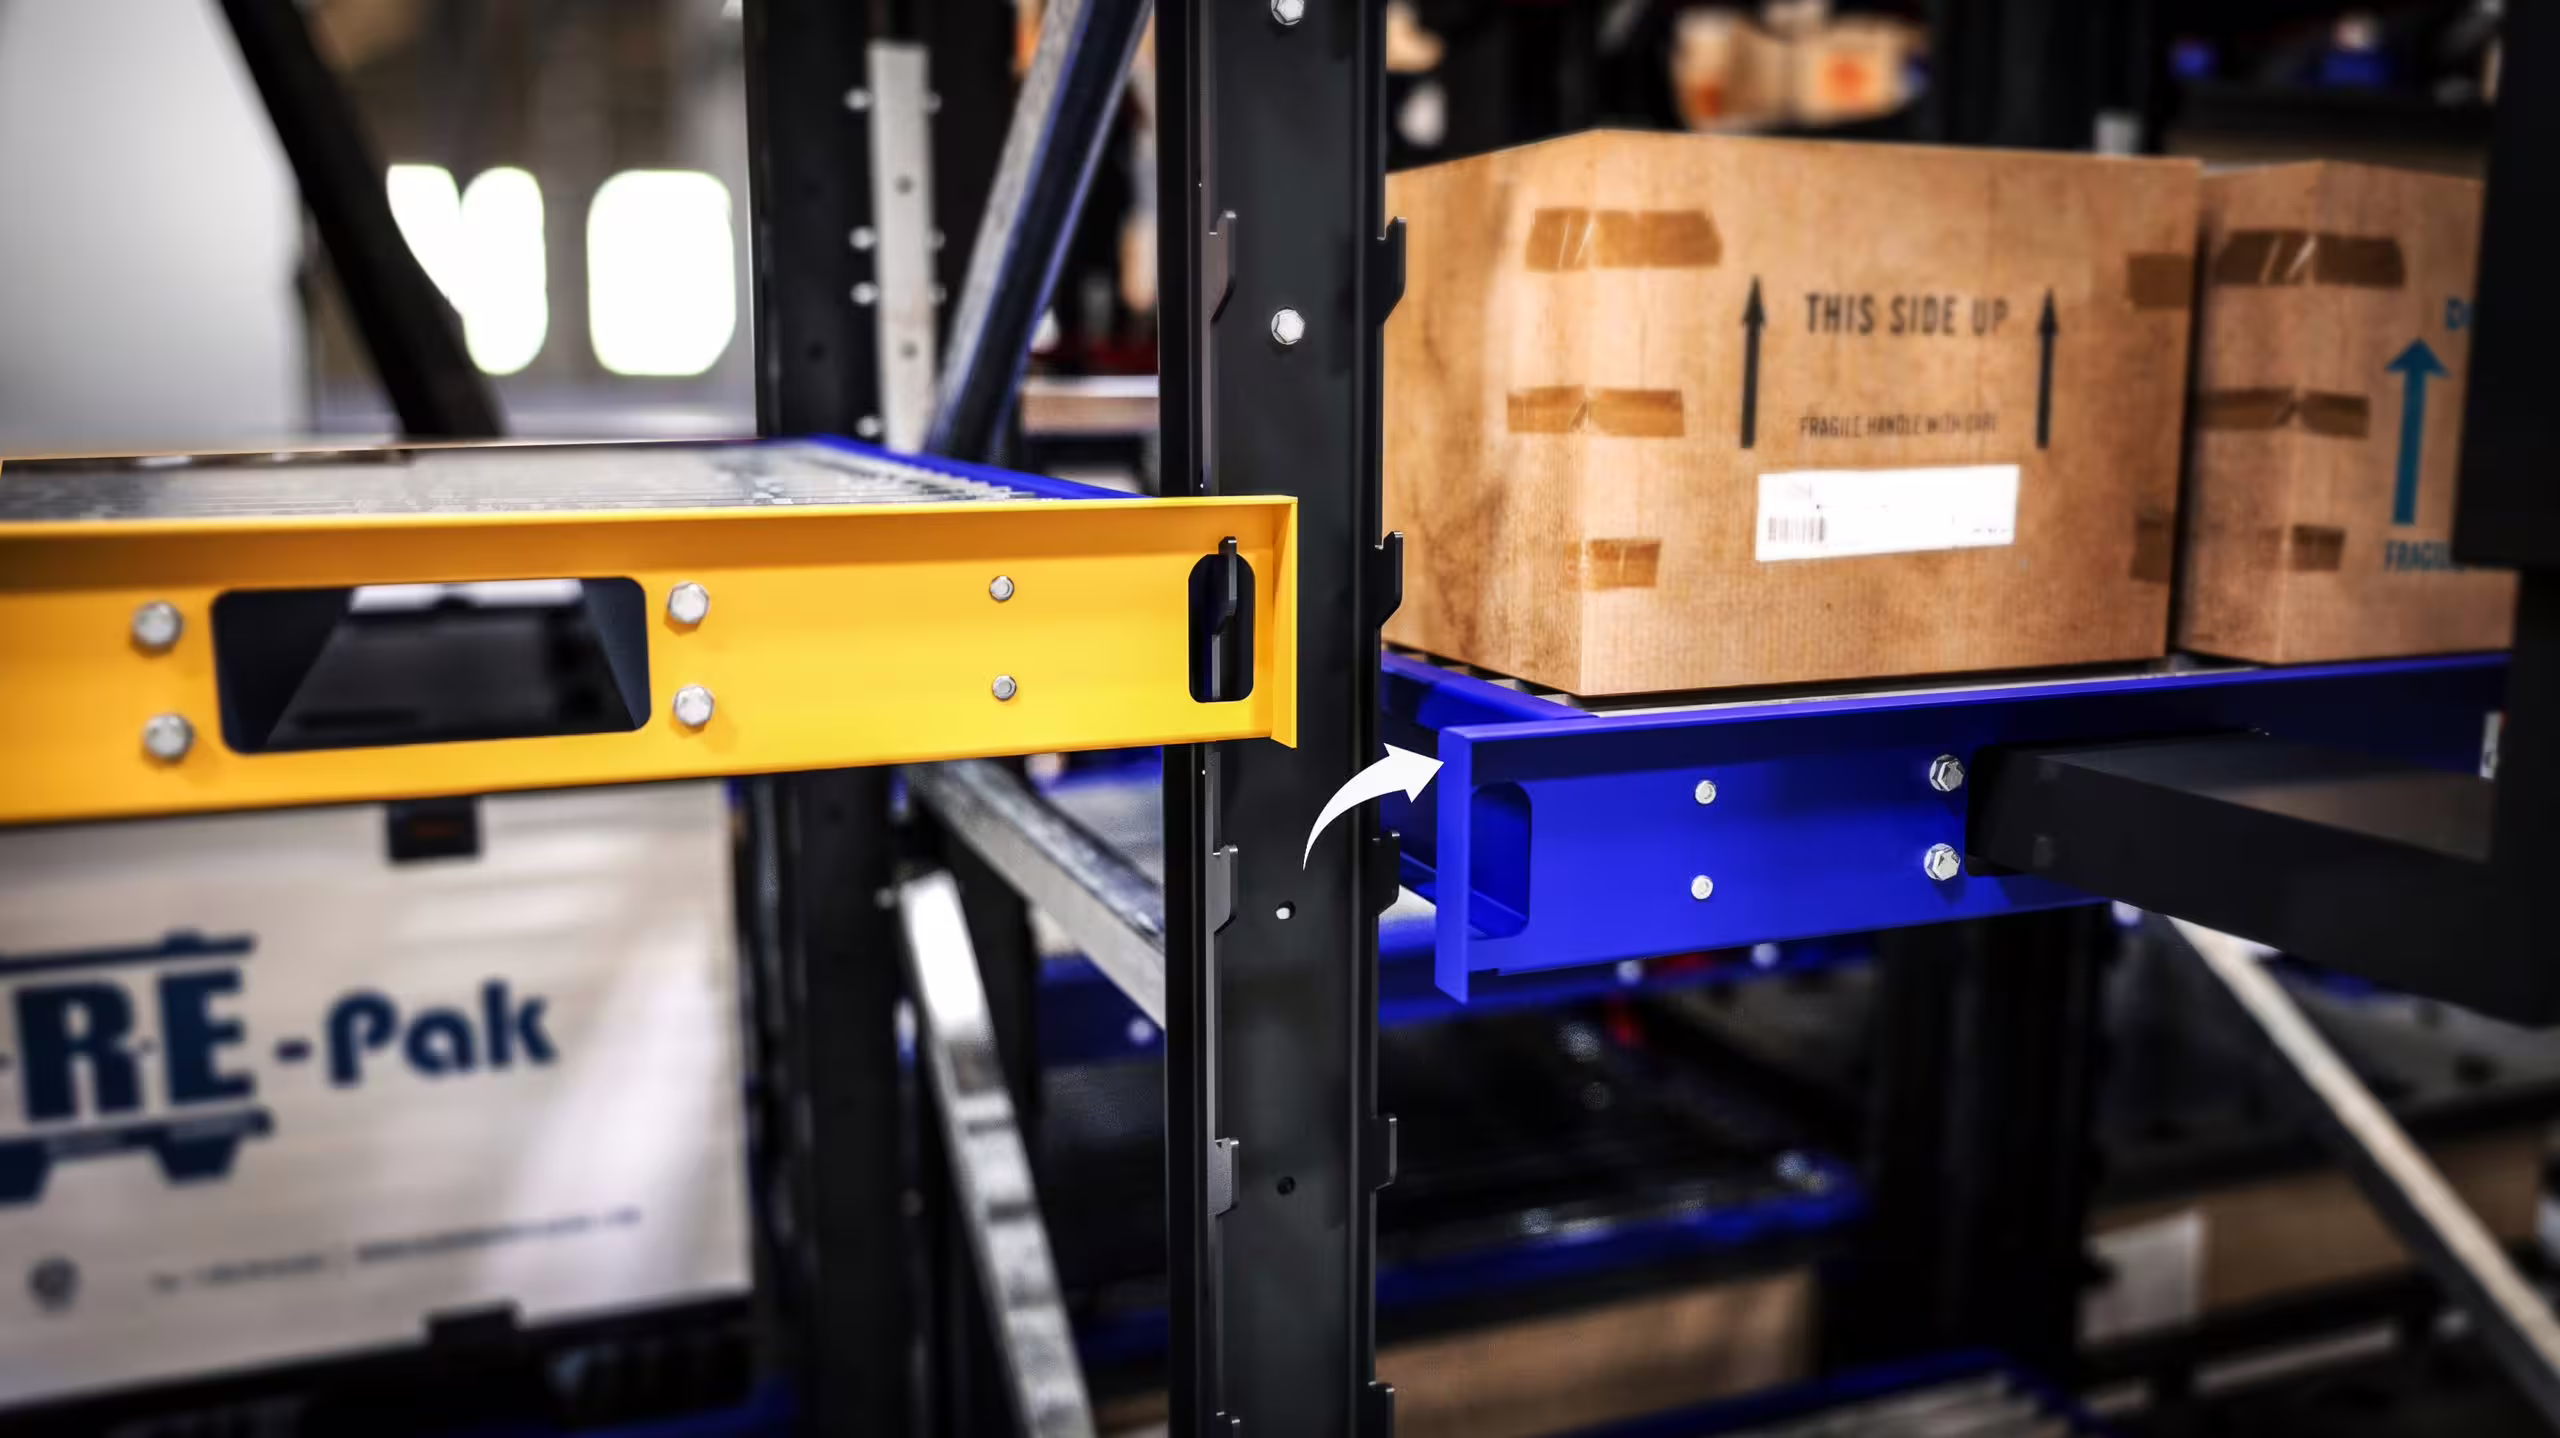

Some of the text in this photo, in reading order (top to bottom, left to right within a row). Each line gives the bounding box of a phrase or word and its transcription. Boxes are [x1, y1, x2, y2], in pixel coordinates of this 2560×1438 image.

[1805, 293, 2010, 337] THIS SIDE UP
[1800, 415, 1862, 438] FRAGILE
[1867, 413, 1921, 436] HANDLE
